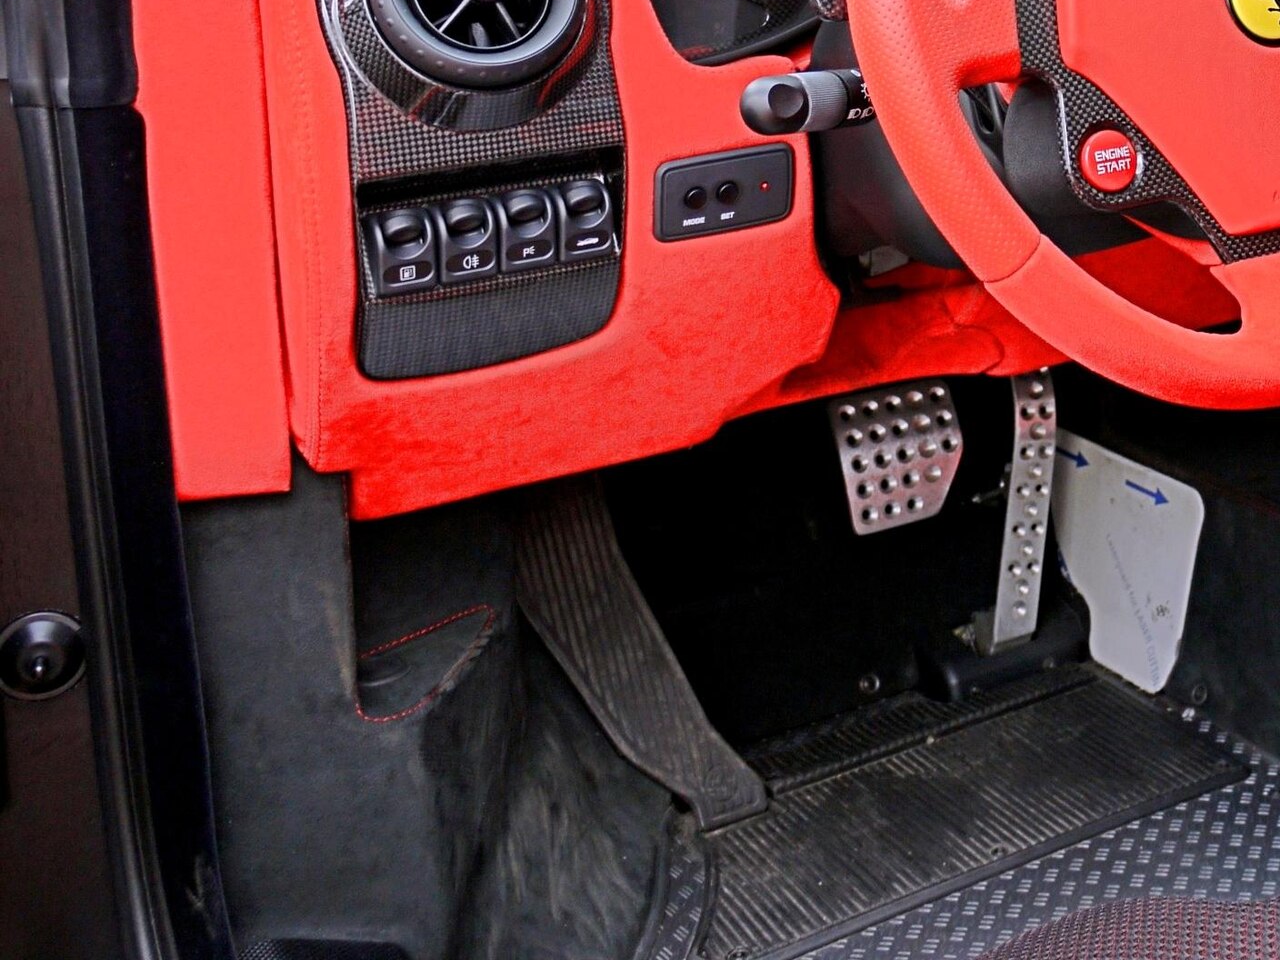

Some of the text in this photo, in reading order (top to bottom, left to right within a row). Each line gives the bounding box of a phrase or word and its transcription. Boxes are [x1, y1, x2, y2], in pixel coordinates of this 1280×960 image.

[1094, 145, 1131, 162] ENGINE
[1096, 158, 1131, 175] START
[682, 216, 706, 227] MODE
[720, 211, 735, 221] SET
